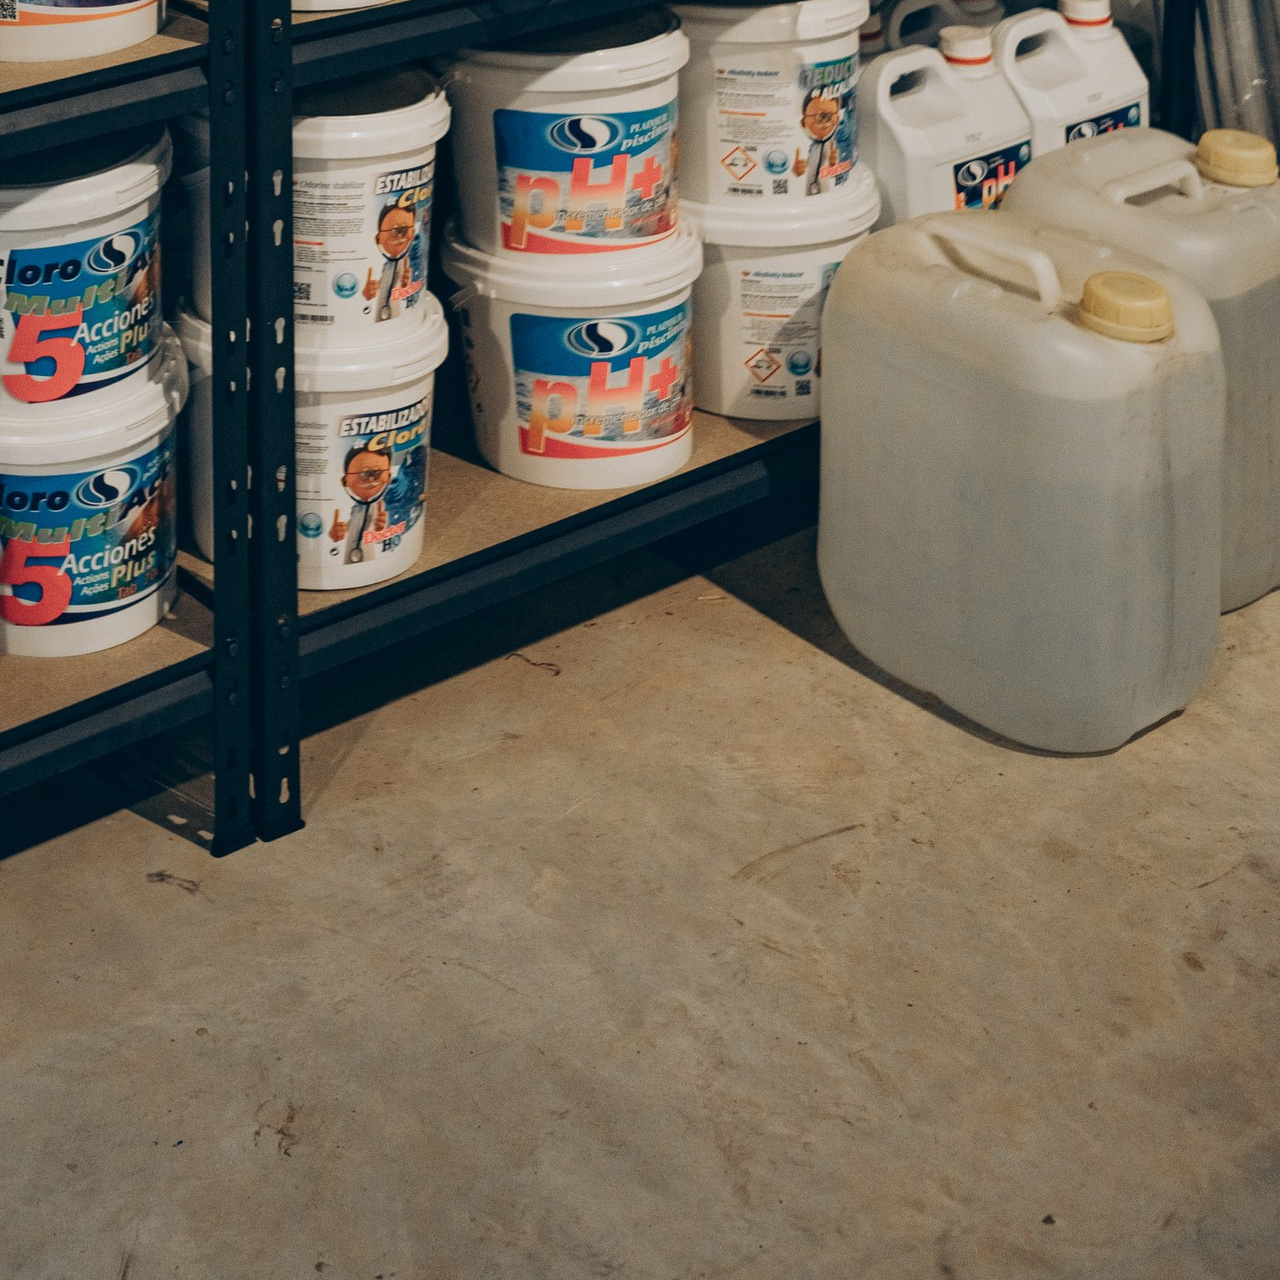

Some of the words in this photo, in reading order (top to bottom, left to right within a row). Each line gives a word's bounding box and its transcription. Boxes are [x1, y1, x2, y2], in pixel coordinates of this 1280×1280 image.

[621, 121, 672, 151] piscinas
[508, 153, 662, 249] pH+
[2, 303, 86, 403] 5
[527, 355, 678, 454] pH+
[57, 525, 156, 577] Acciones
[111, 550, 155, 587] Plus
